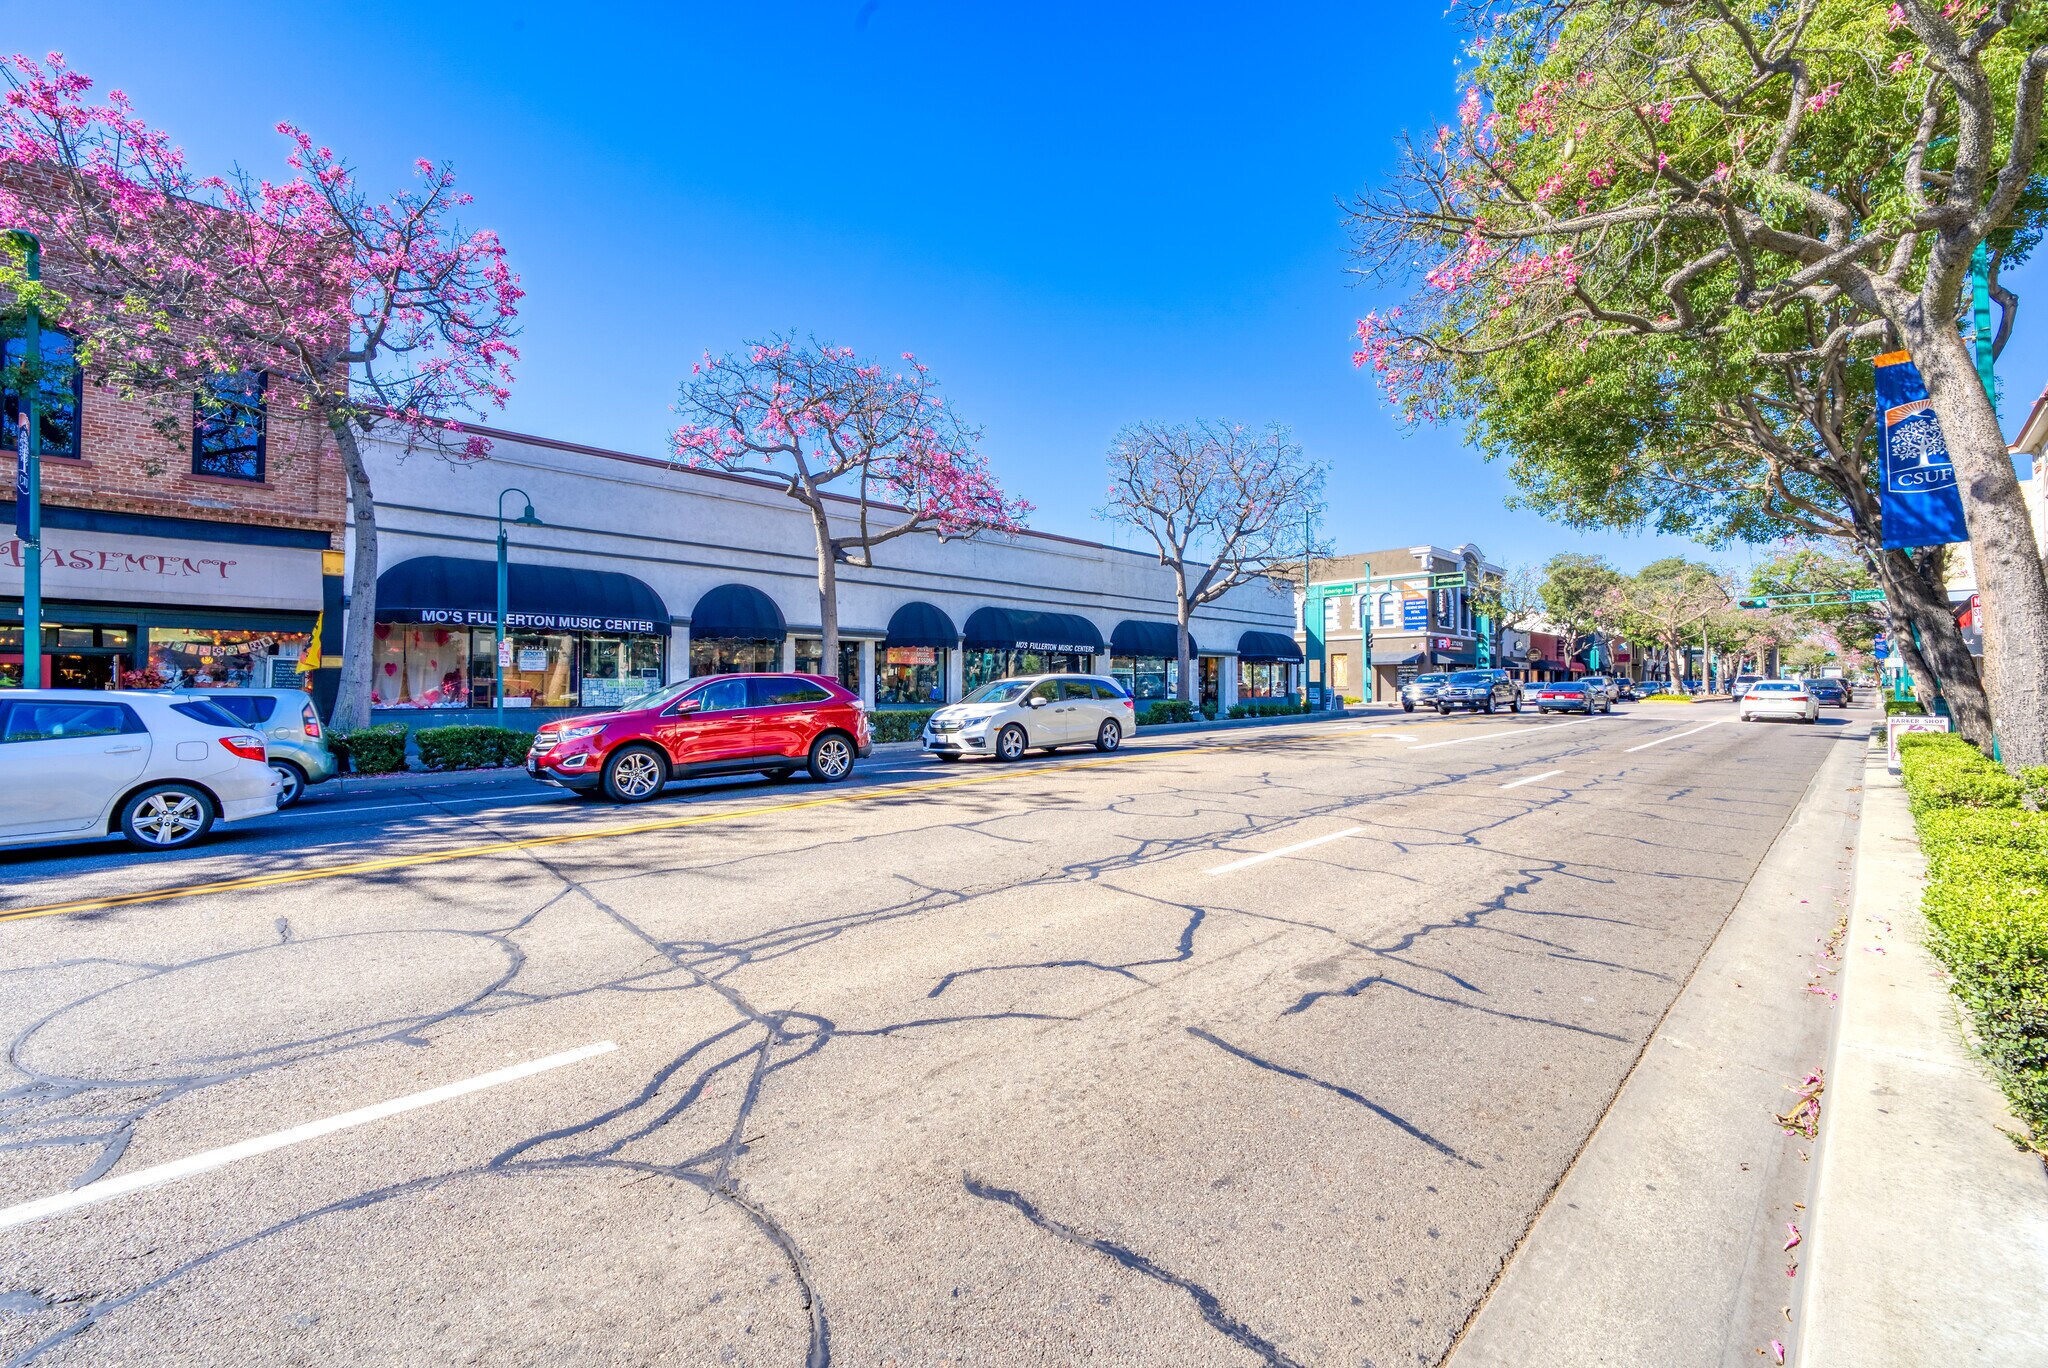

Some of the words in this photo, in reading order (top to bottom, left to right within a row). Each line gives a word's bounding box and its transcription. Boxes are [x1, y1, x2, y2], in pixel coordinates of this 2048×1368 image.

[1898, 468, 1953, 487] CSUF
[422, 610, 463, 623] MO'S
[467, 611, 555, 627] FULERTON
[558, 616, 602, 629] MUSIC
[604, 619, 654, 632] CENTER
[1029, 642, 1058, 651] FULLERTON
[1058, 644, 1073, 652] MUSIC
[1074, 645, 1095, 653] CENTERS
